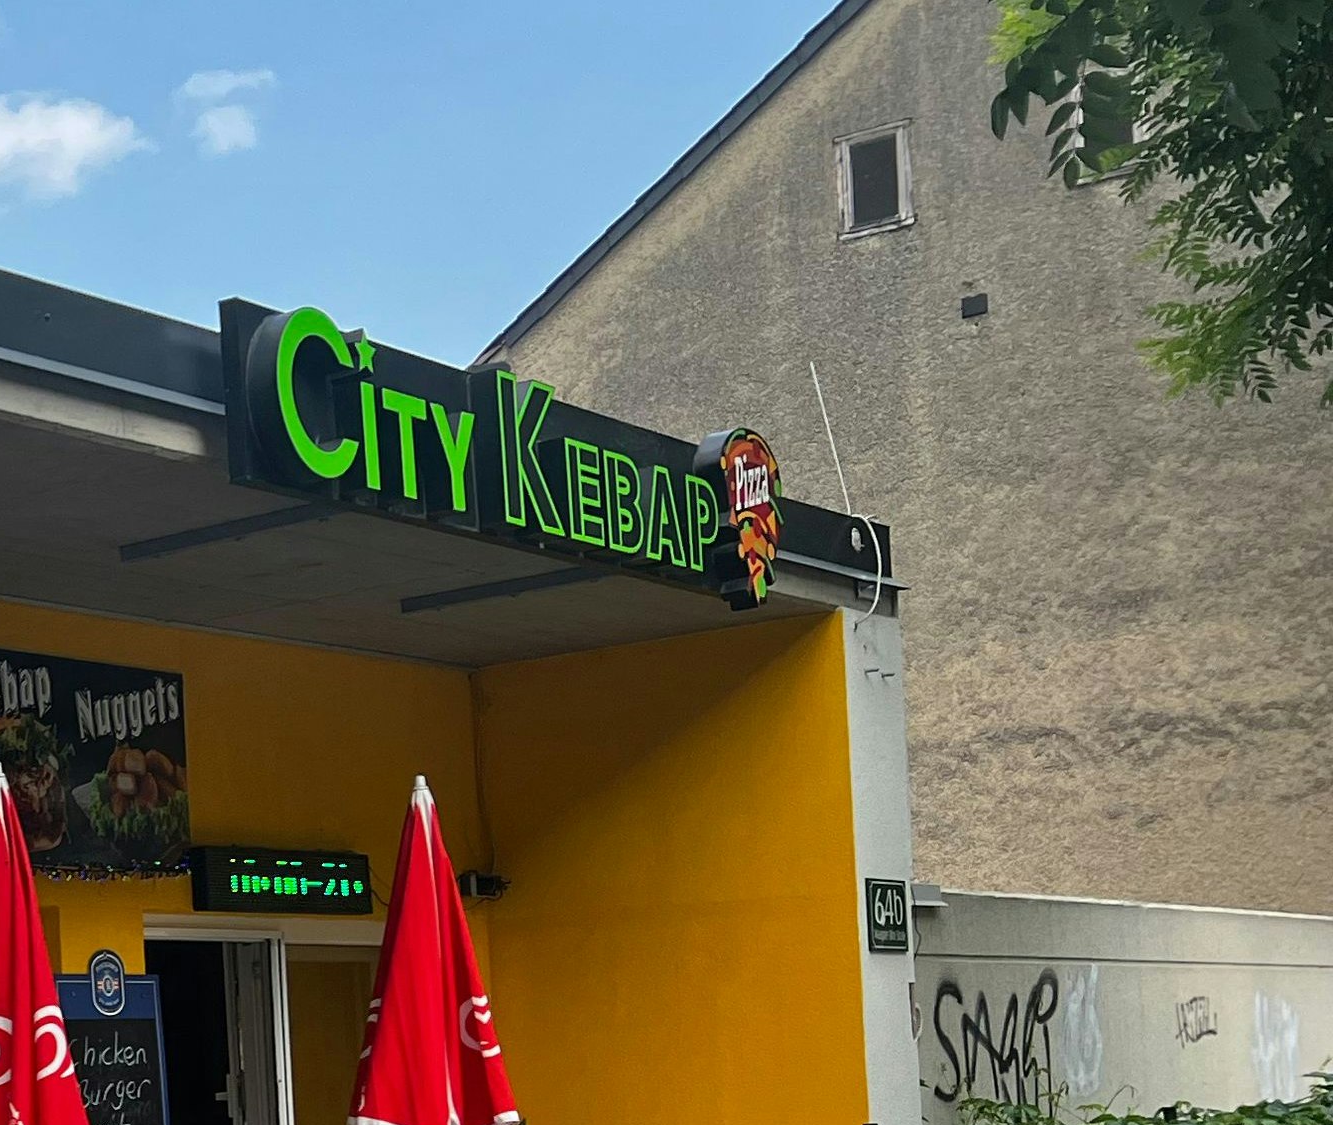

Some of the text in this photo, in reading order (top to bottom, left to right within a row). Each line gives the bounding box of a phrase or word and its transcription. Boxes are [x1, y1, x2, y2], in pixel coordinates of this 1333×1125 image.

[734, 453, 770, 512] Pizza
[73, 674, 182, 745] Nuggets
[874, 887, 904, 927] 64b
